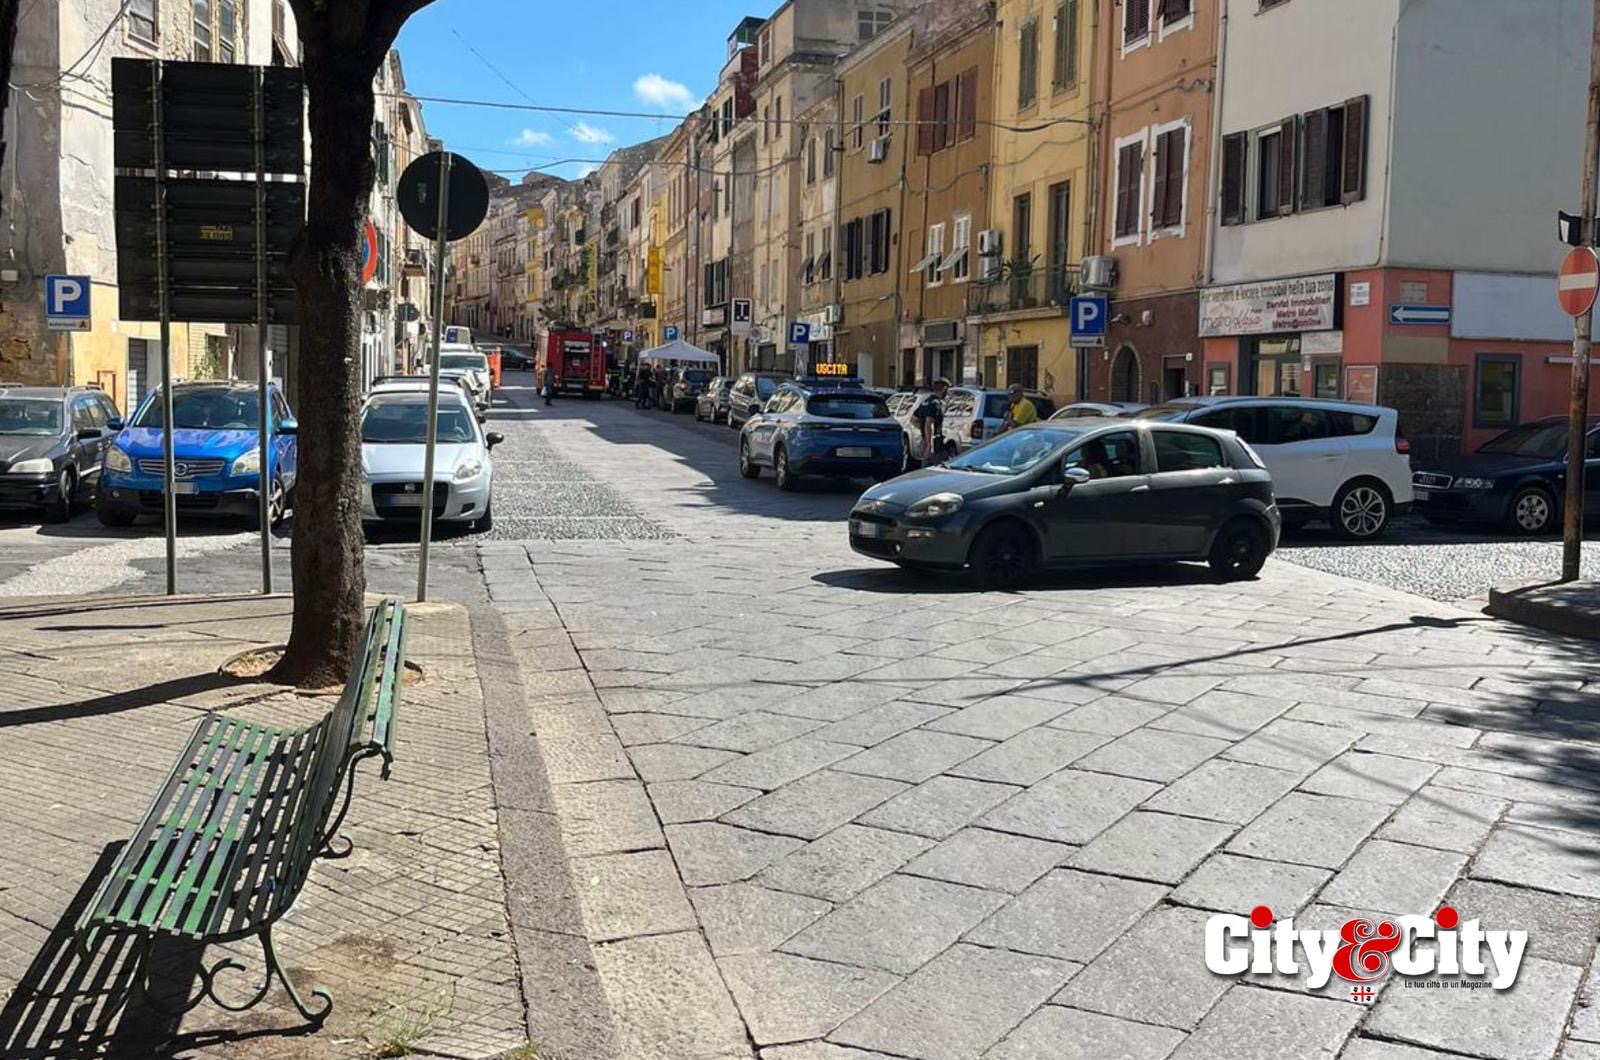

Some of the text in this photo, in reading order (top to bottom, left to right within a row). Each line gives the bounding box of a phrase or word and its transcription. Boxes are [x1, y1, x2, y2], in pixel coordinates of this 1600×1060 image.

[54, 279, 82, 313] P
[1078, 302, 1098, 330] P
[624, 331, 632, 340] P
[666, 328, 675, 338] P
[792, 324, 806, 342] P
[815, 363, 848, 376] USCITA
